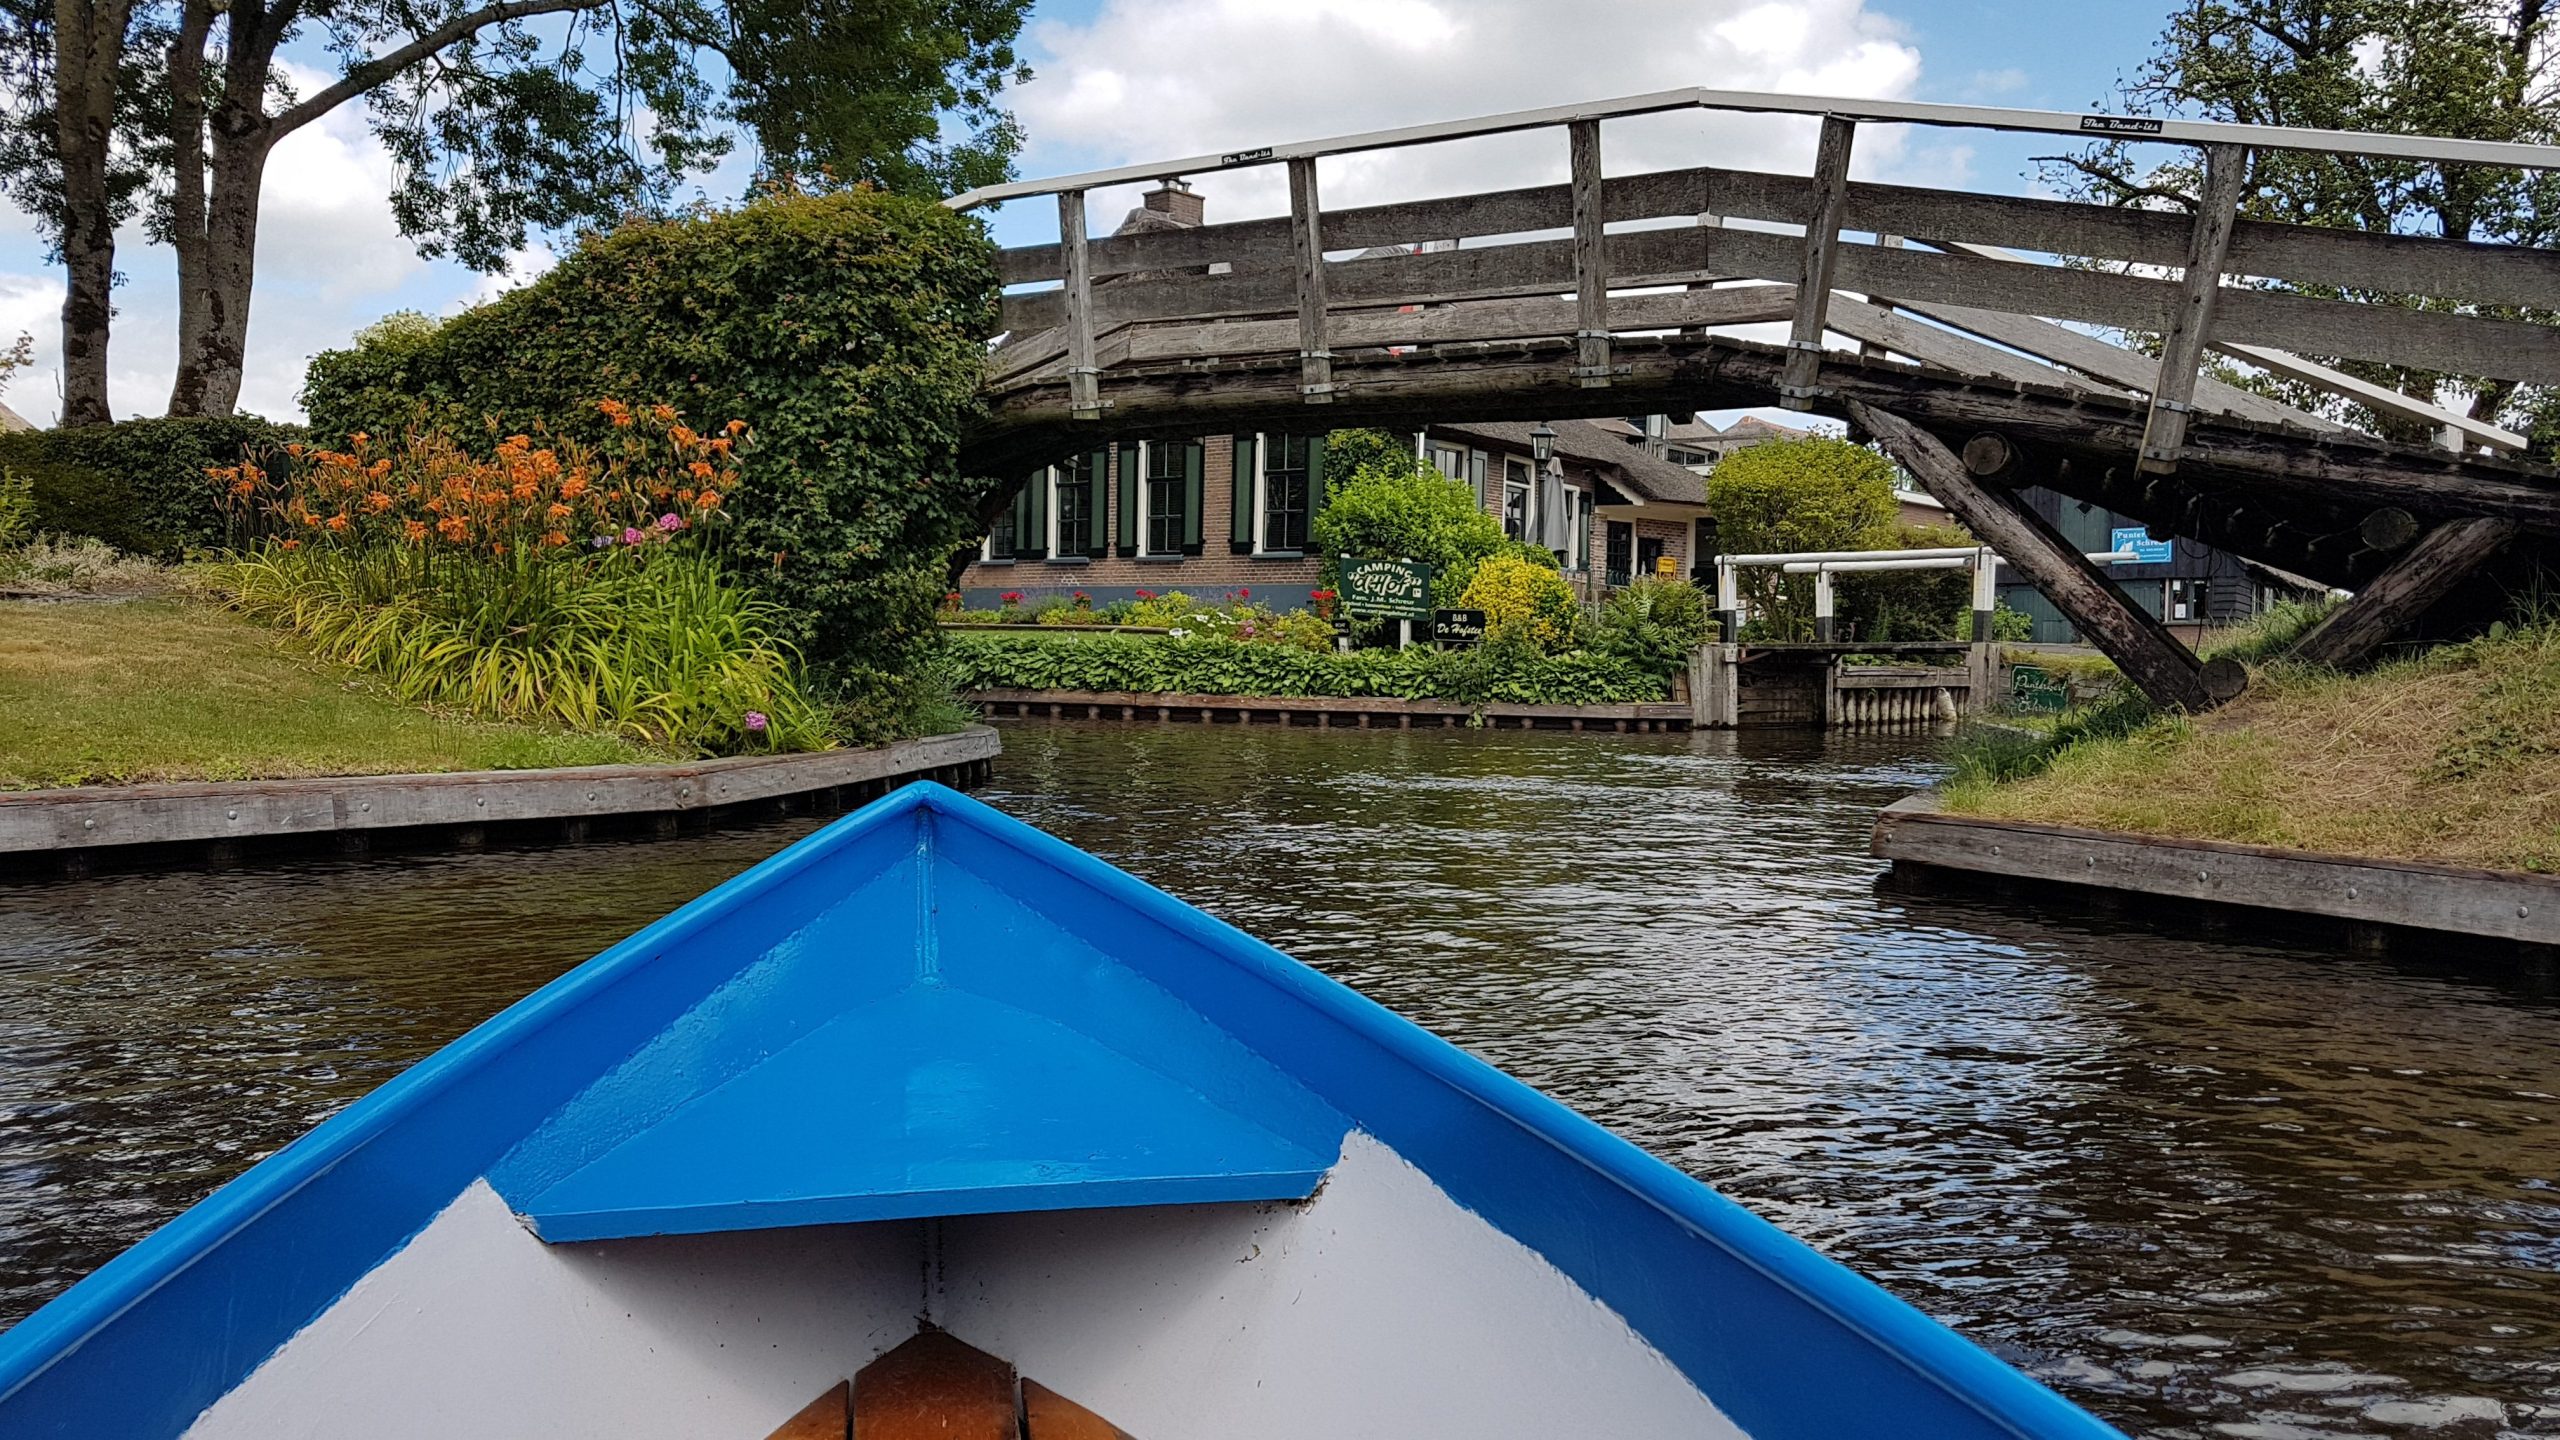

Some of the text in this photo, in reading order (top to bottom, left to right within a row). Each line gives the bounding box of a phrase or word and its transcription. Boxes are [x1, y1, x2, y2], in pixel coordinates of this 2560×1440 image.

[1357, 562, 1413, 578] CAMPING
[1452, 613, 1468, 622] B&B
[1437, 623, 1482, 637] De Hofstee
